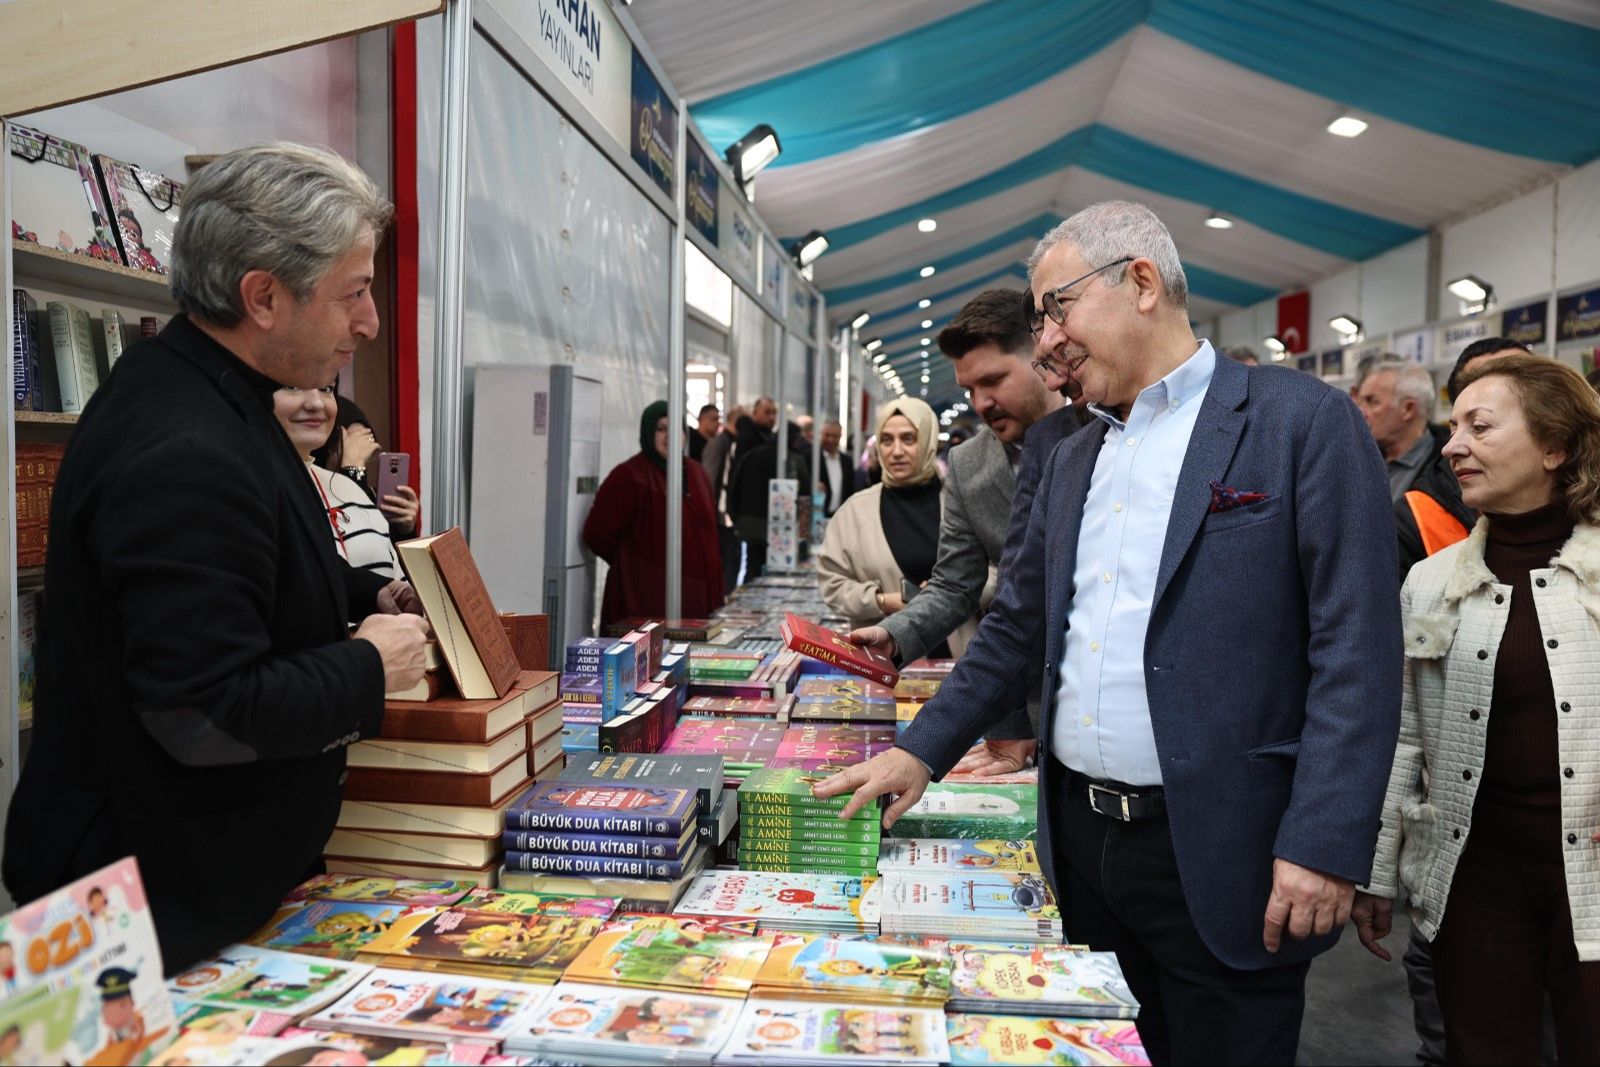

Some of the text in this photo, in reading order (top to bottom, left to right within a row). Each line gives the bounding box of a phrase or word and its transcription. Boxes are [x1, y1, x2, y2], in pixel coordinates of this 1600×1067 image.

[556, 0, 601, 61] HAN
[538, 0, 594, 96] YAYINLARI
[577, 656, 600, 664] ADEM
[531, 813, 641, 832] BÜYÜK DUA KİTABI
[528, 835, 638, 855] BÜYÜK DUA KİTABI
[531, 855, 642, 874] BÜYÜK DUA KİTABI
